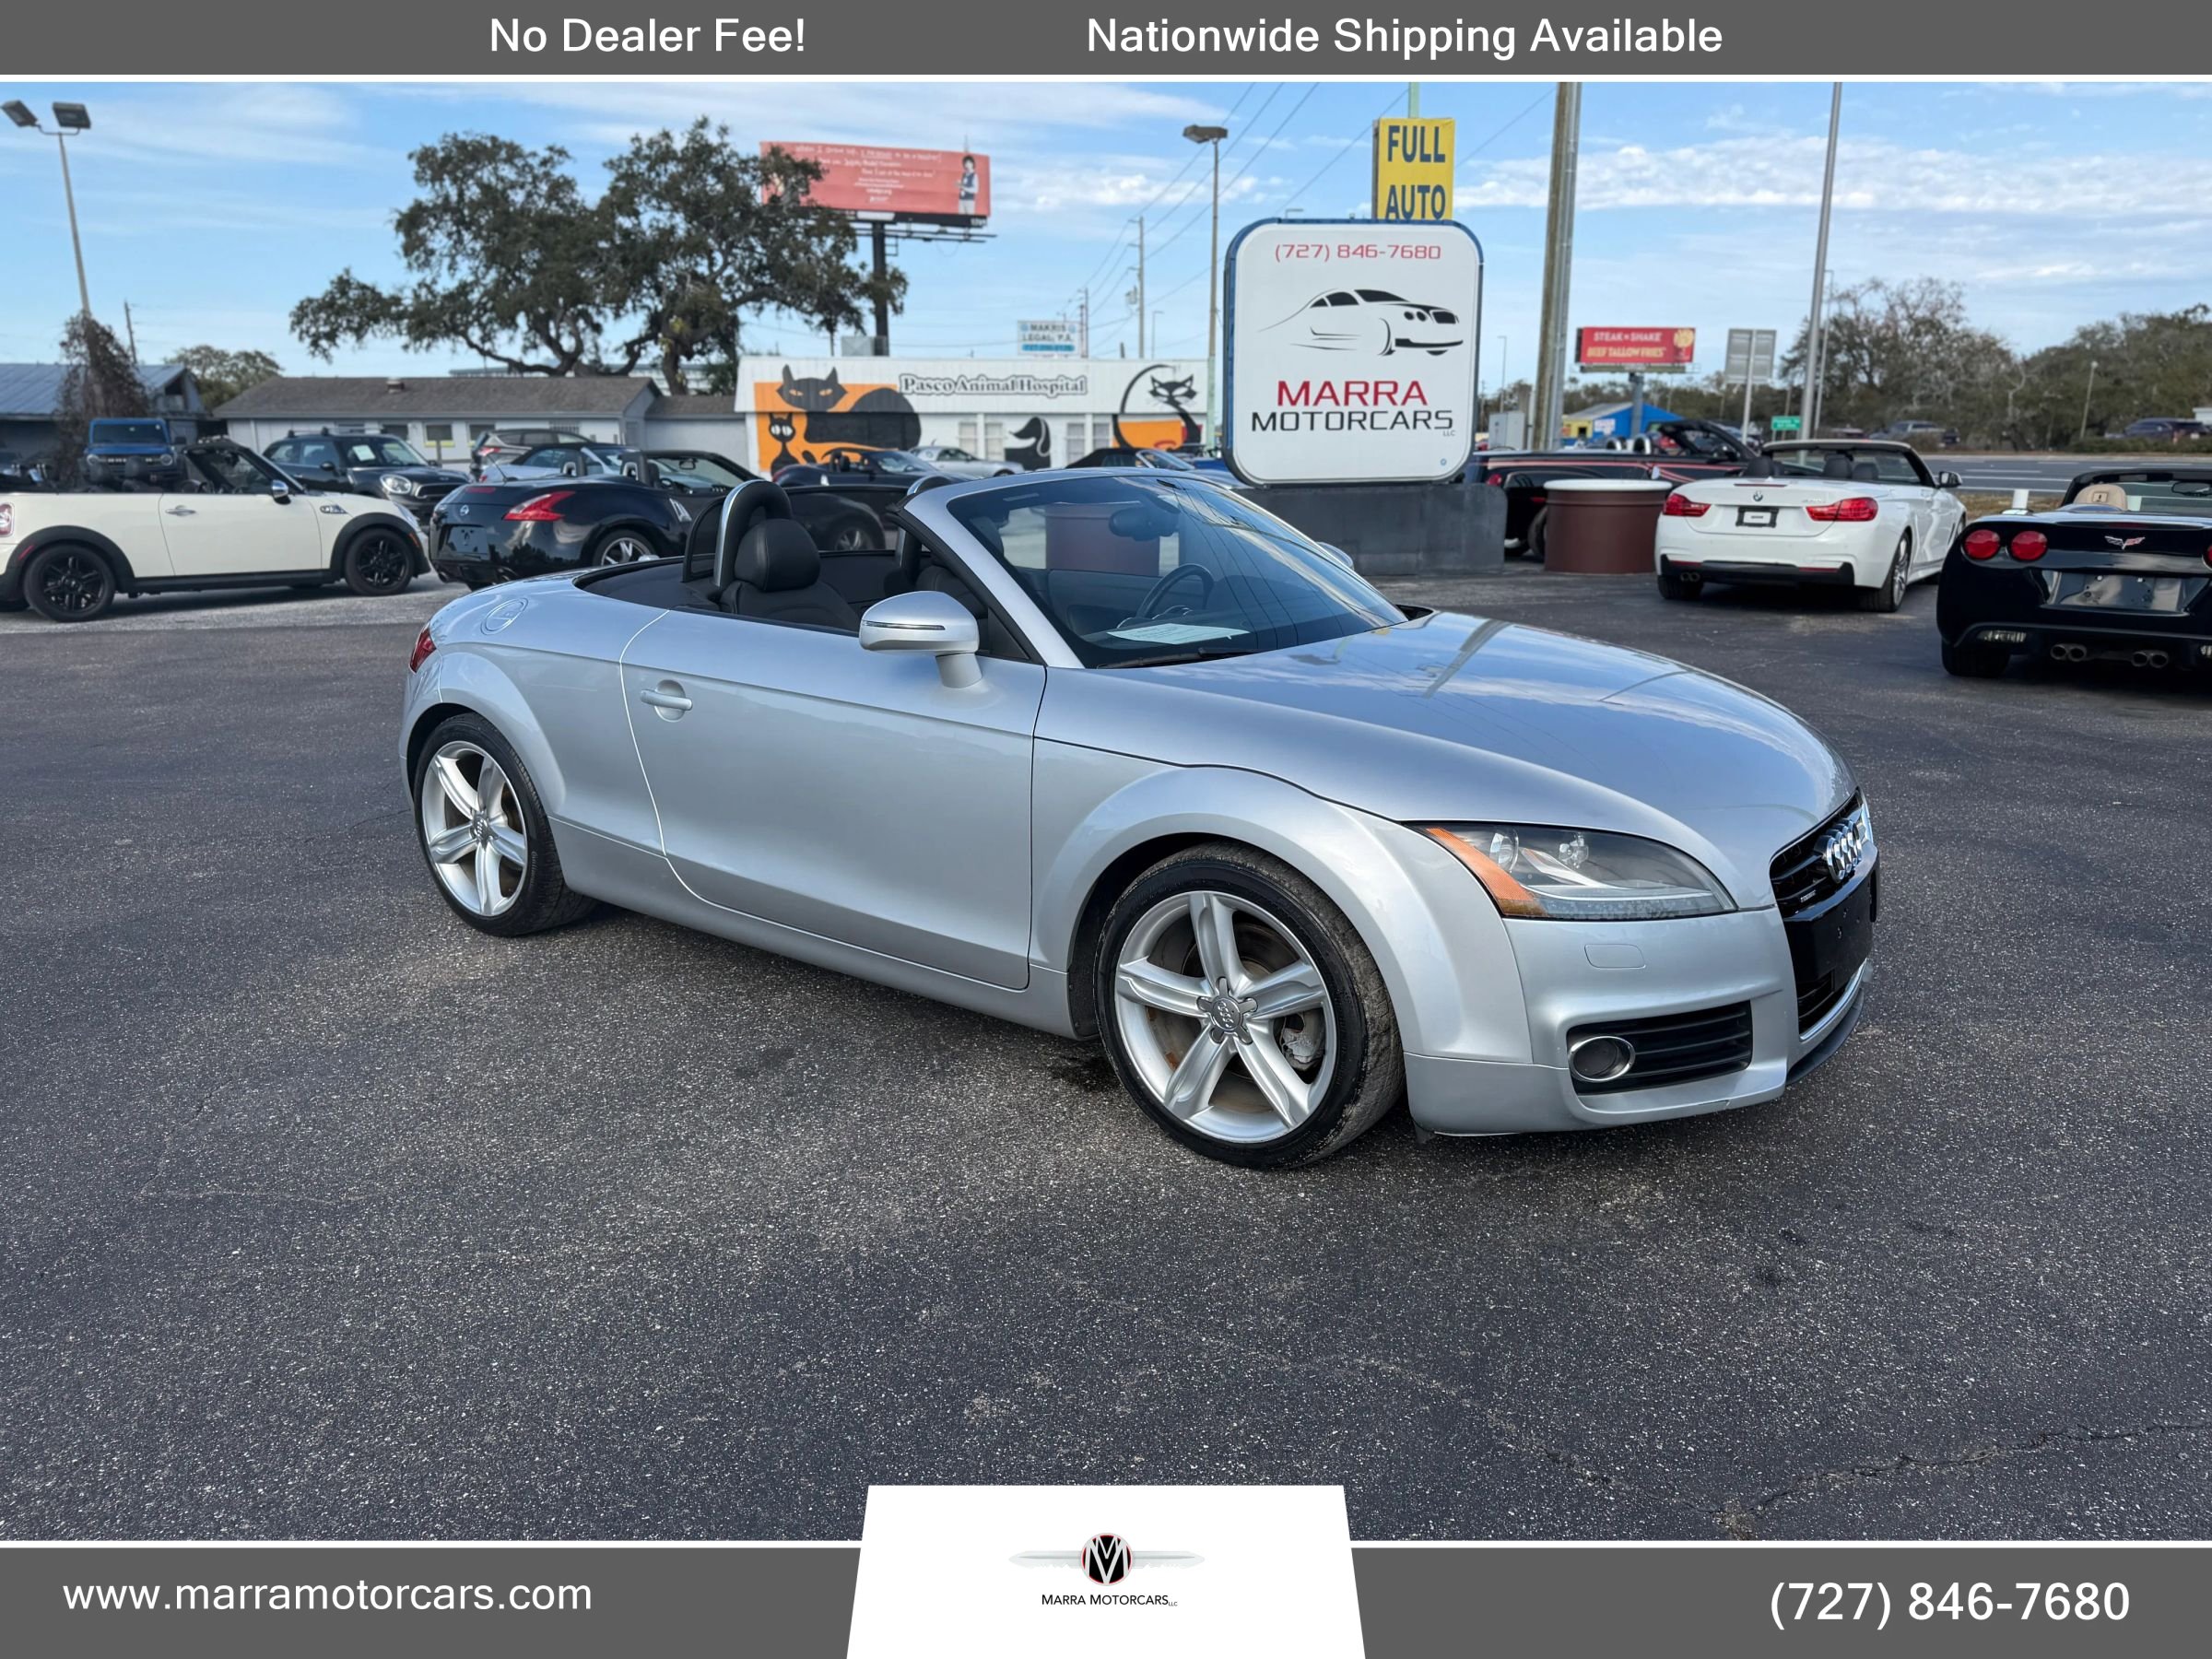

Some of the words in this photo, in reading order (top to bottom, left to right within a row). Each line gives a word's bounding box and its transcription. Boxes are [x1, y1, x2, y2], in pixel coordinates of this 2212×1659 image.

[1387, 124, 1446, 163] FULL
[1384, 183, 1446, 220] AUTO
[1275, 244, 1331, 263] (727)
[1336, 244, 1441, 260] 846-7680
[1593, 331, 1623, 342] STEAK
[1630, 332, 1662, 342] SHAKE
[902, 376, 954, 393] Pasco
[956, 375, 1015, 393] Animal
[1018, 375, 1086, 396] Hospital
[1277, 380, 1429, 406] MARRA
[1252, 410, 1453, 431] MOTORCARS
